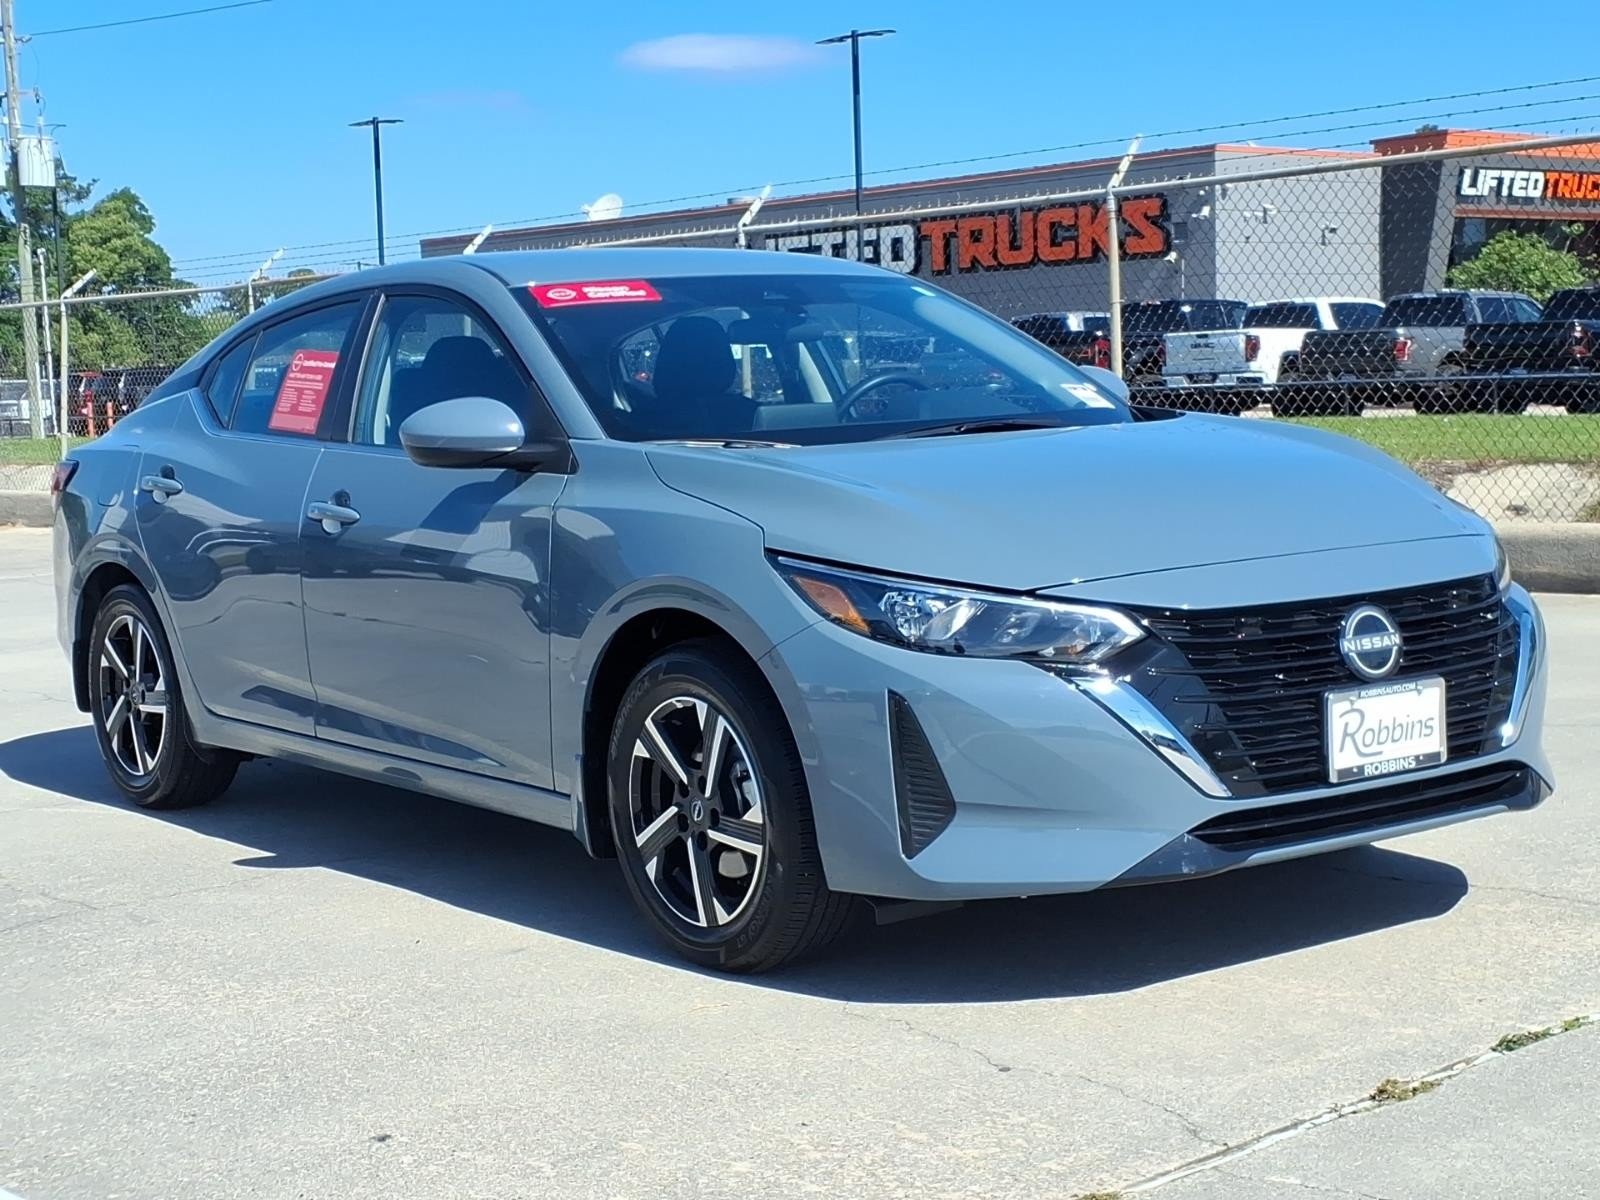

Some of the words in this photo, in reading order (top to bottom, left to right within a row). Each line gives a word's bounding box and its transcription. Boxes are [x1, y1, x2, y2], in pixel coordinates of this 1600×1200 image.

[1460, 168, 1545, 198] LIFTED
[920, 198, 1165, 272] TRUCKS
[1343, 633, 1400, 651] NISSAN
[1339, 708, 1434, 758] Robbins
[1364, 756, 1416, 776] ROBBINS
